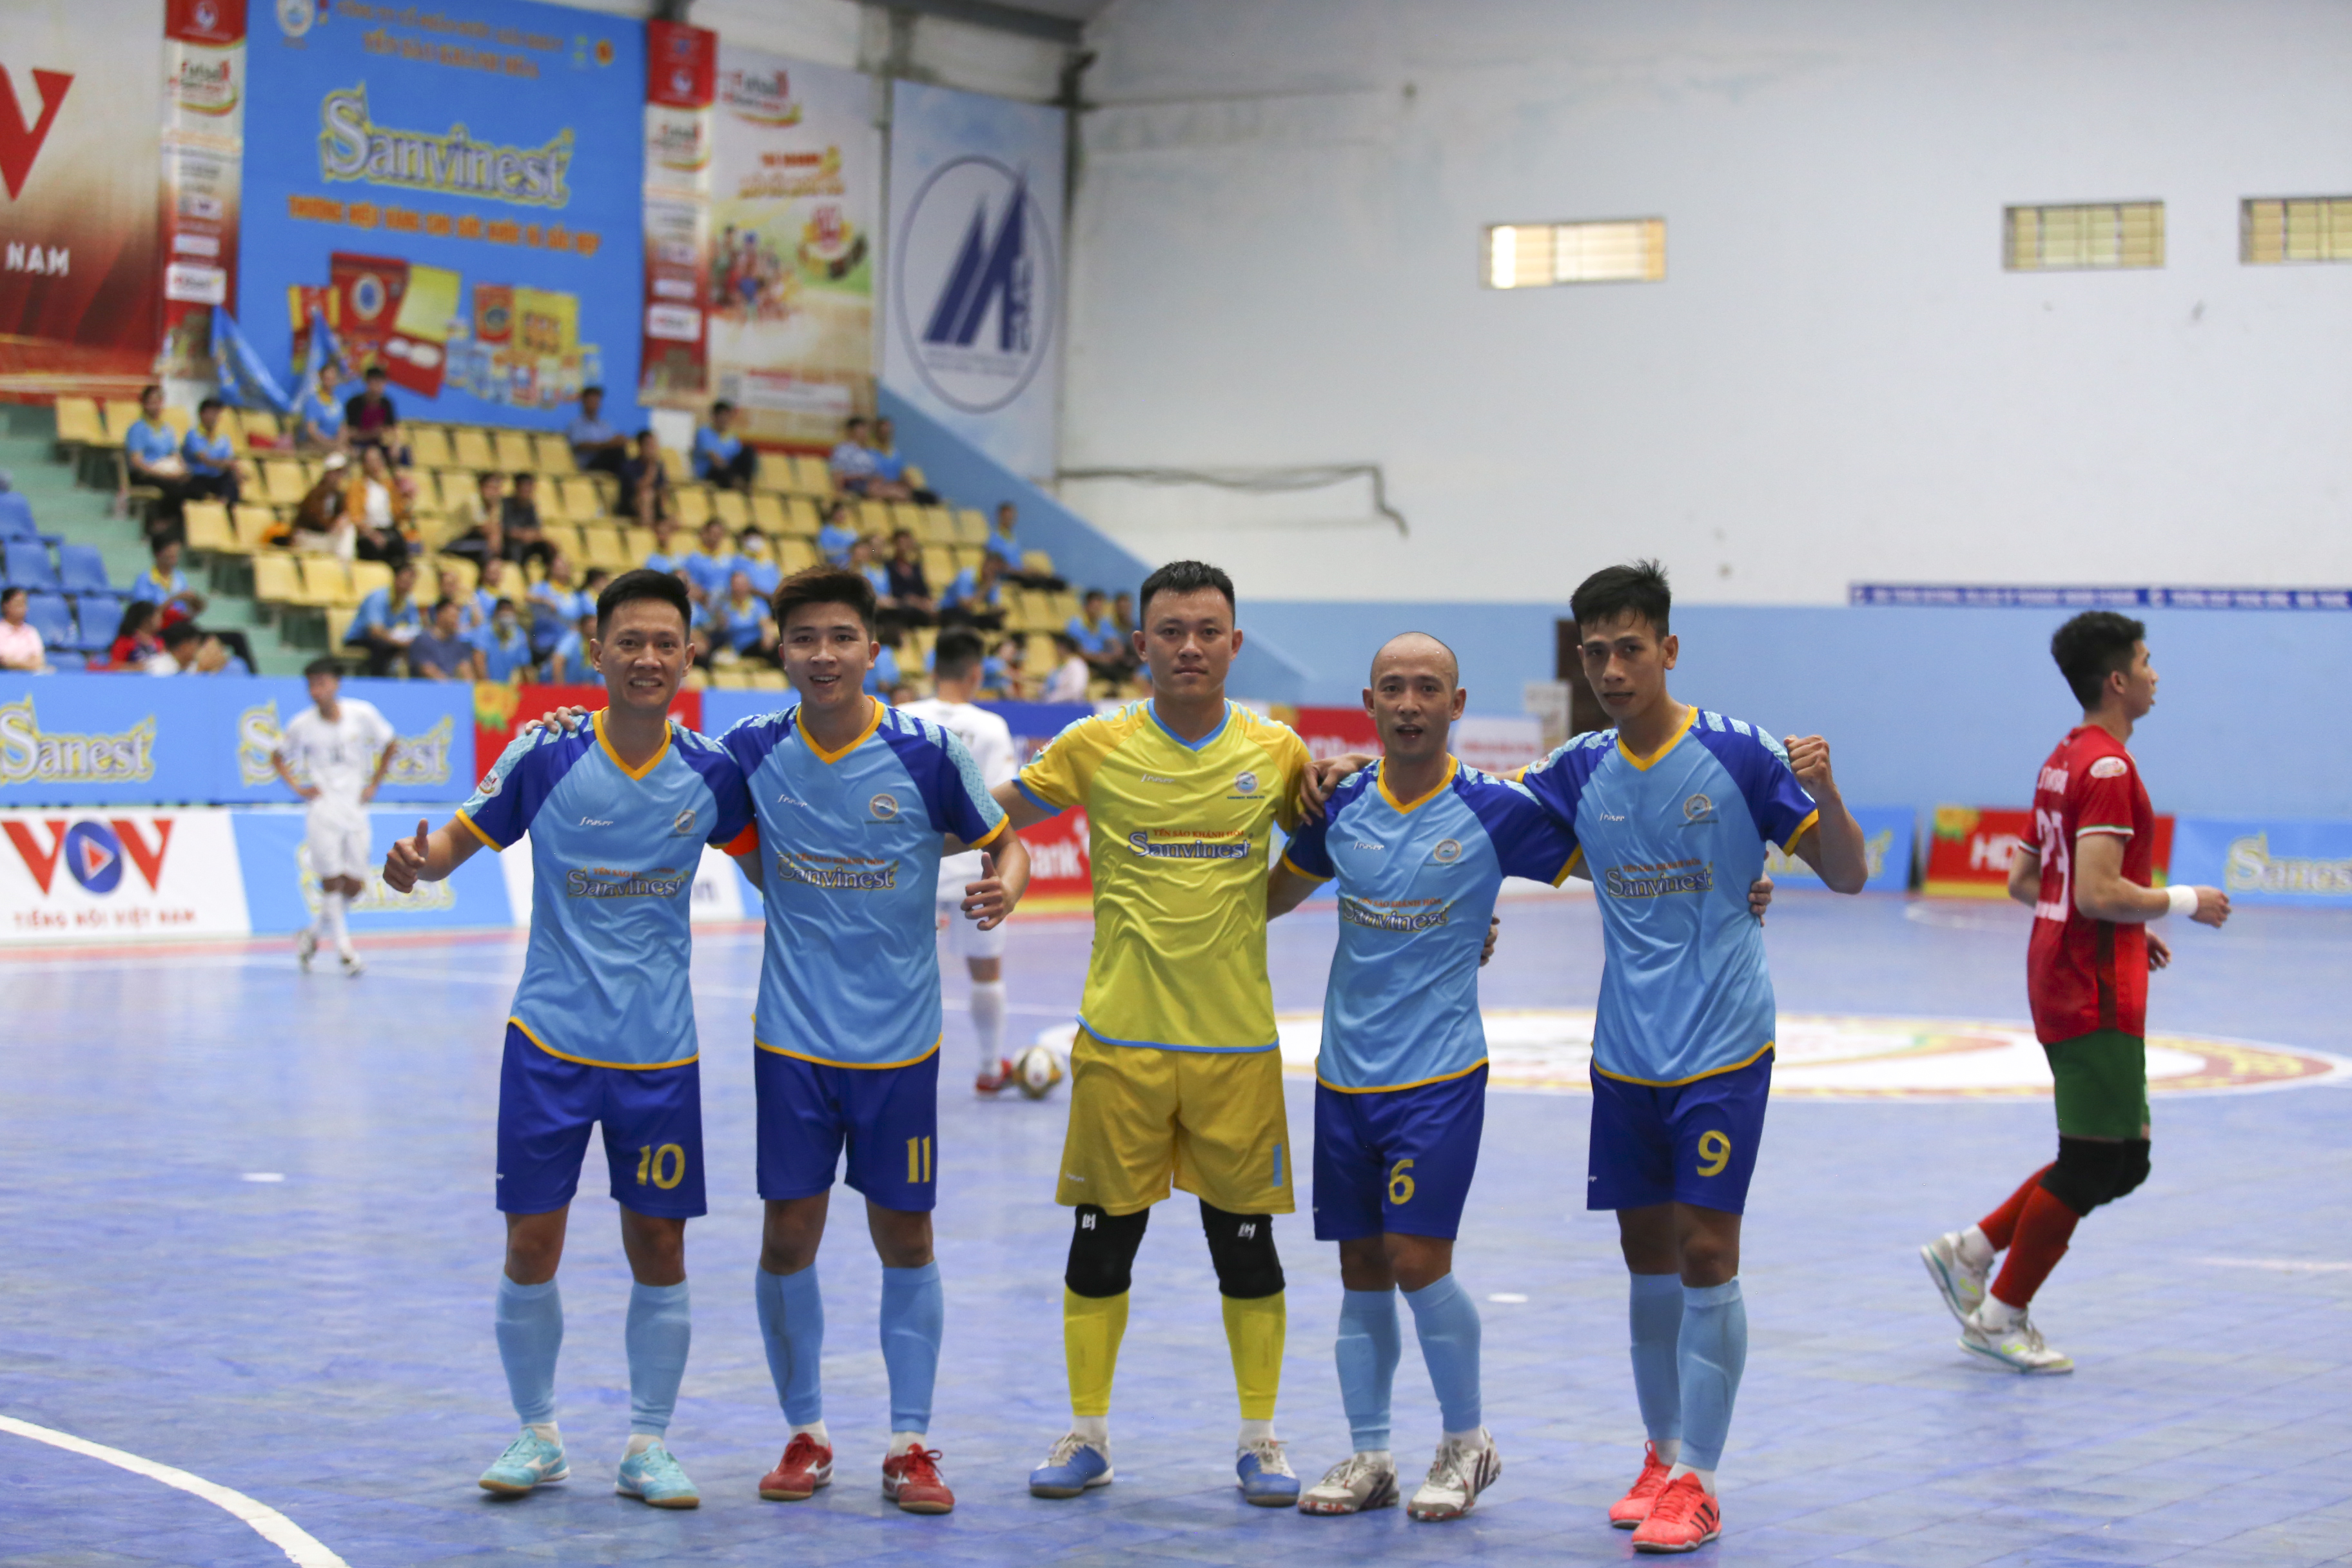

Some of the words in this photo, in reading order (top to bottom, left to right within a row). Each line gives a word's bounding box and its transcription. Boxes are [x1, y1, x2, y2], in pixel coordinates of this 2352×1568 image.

[324, 87, 570, 203] Sanvinest
[6, 241, 70, 277] NAM
[0, 698, 155, 781] Sanest
[1128, 831, 1251, 858] Sanvinest
[568, 867, 685, 897] Sanvinest
[1606, 867, 1714, 897] Sanvinest
[637, 1143, 685, 1190] 10
[906, 1135, 931, 1183] 11
[1696, 1130, 1731, 1177] 9
[1389, 1159, 1415, 1205] 6
